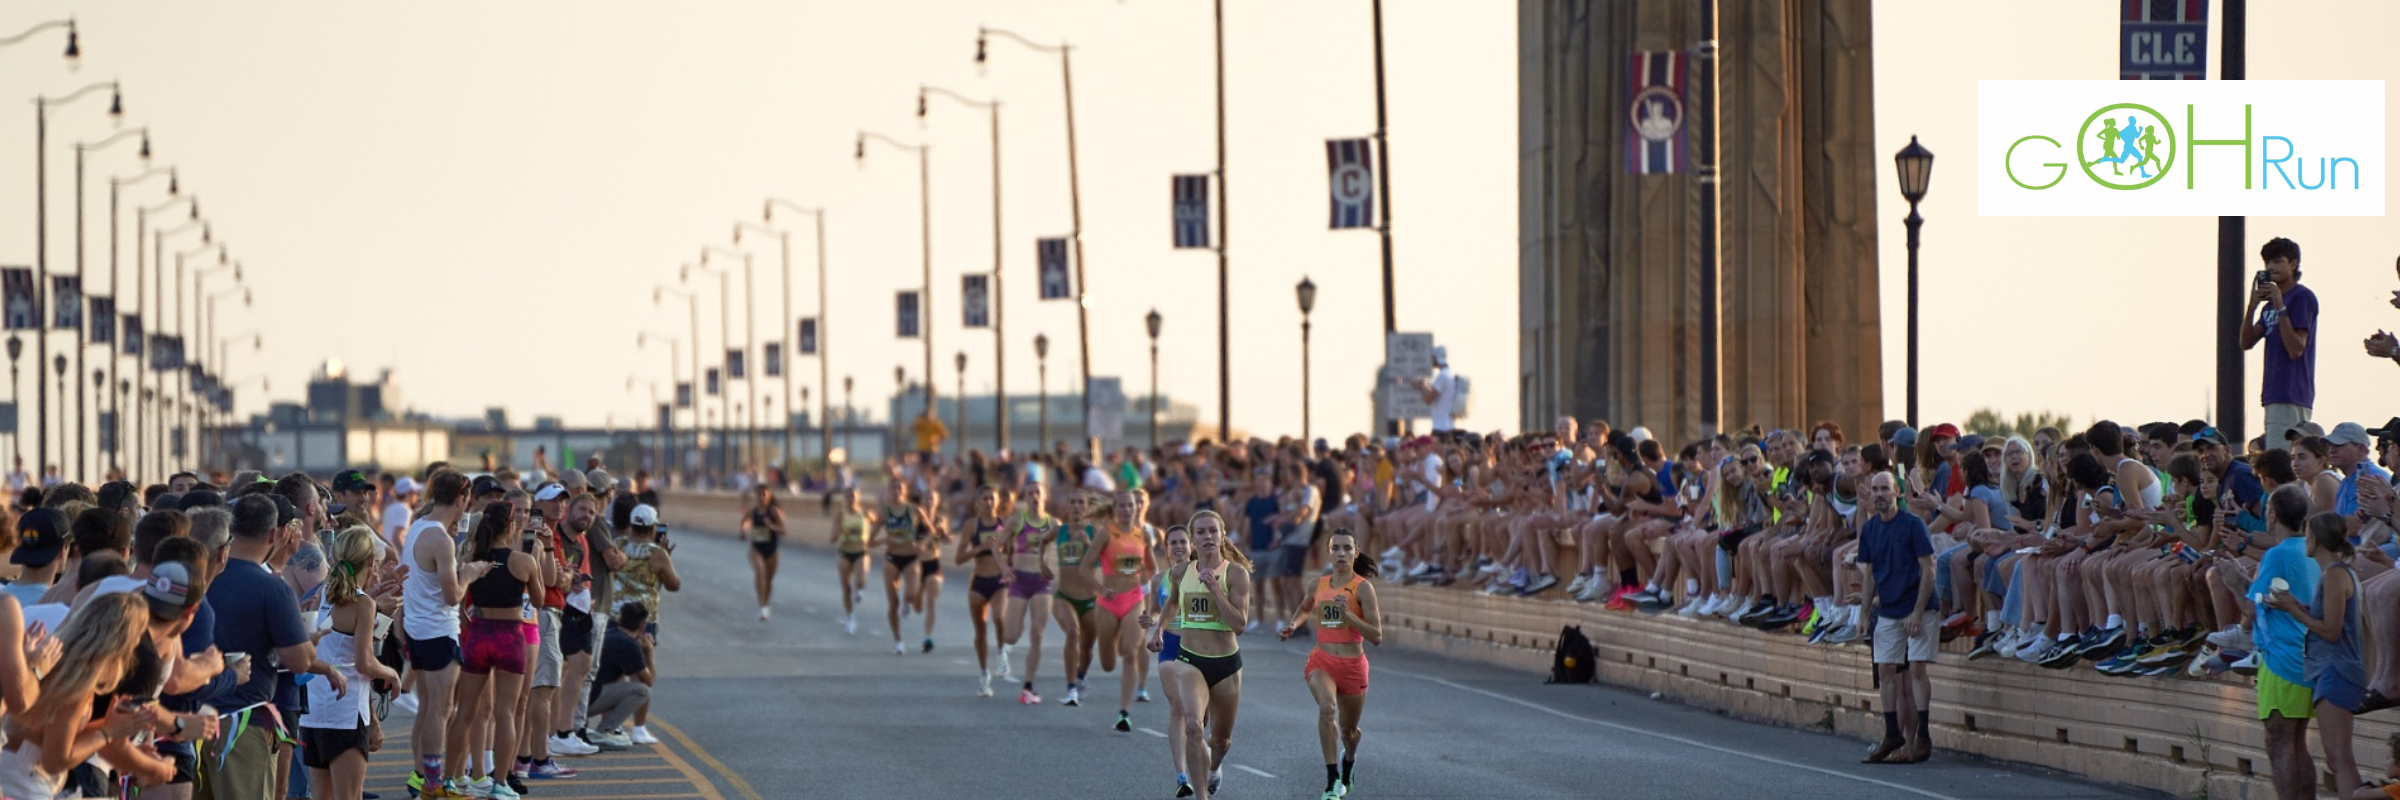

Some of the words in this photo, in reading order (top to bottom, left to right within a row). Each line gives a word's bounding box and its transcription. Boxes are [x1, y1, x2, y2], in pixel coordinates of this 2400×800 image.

[2130, 31, 2195, 64] CLE
[1342, 169, 1361, 199] C
[1191, 597, 1209, 613] 30
[1323, 605, 1340, 620] 36
